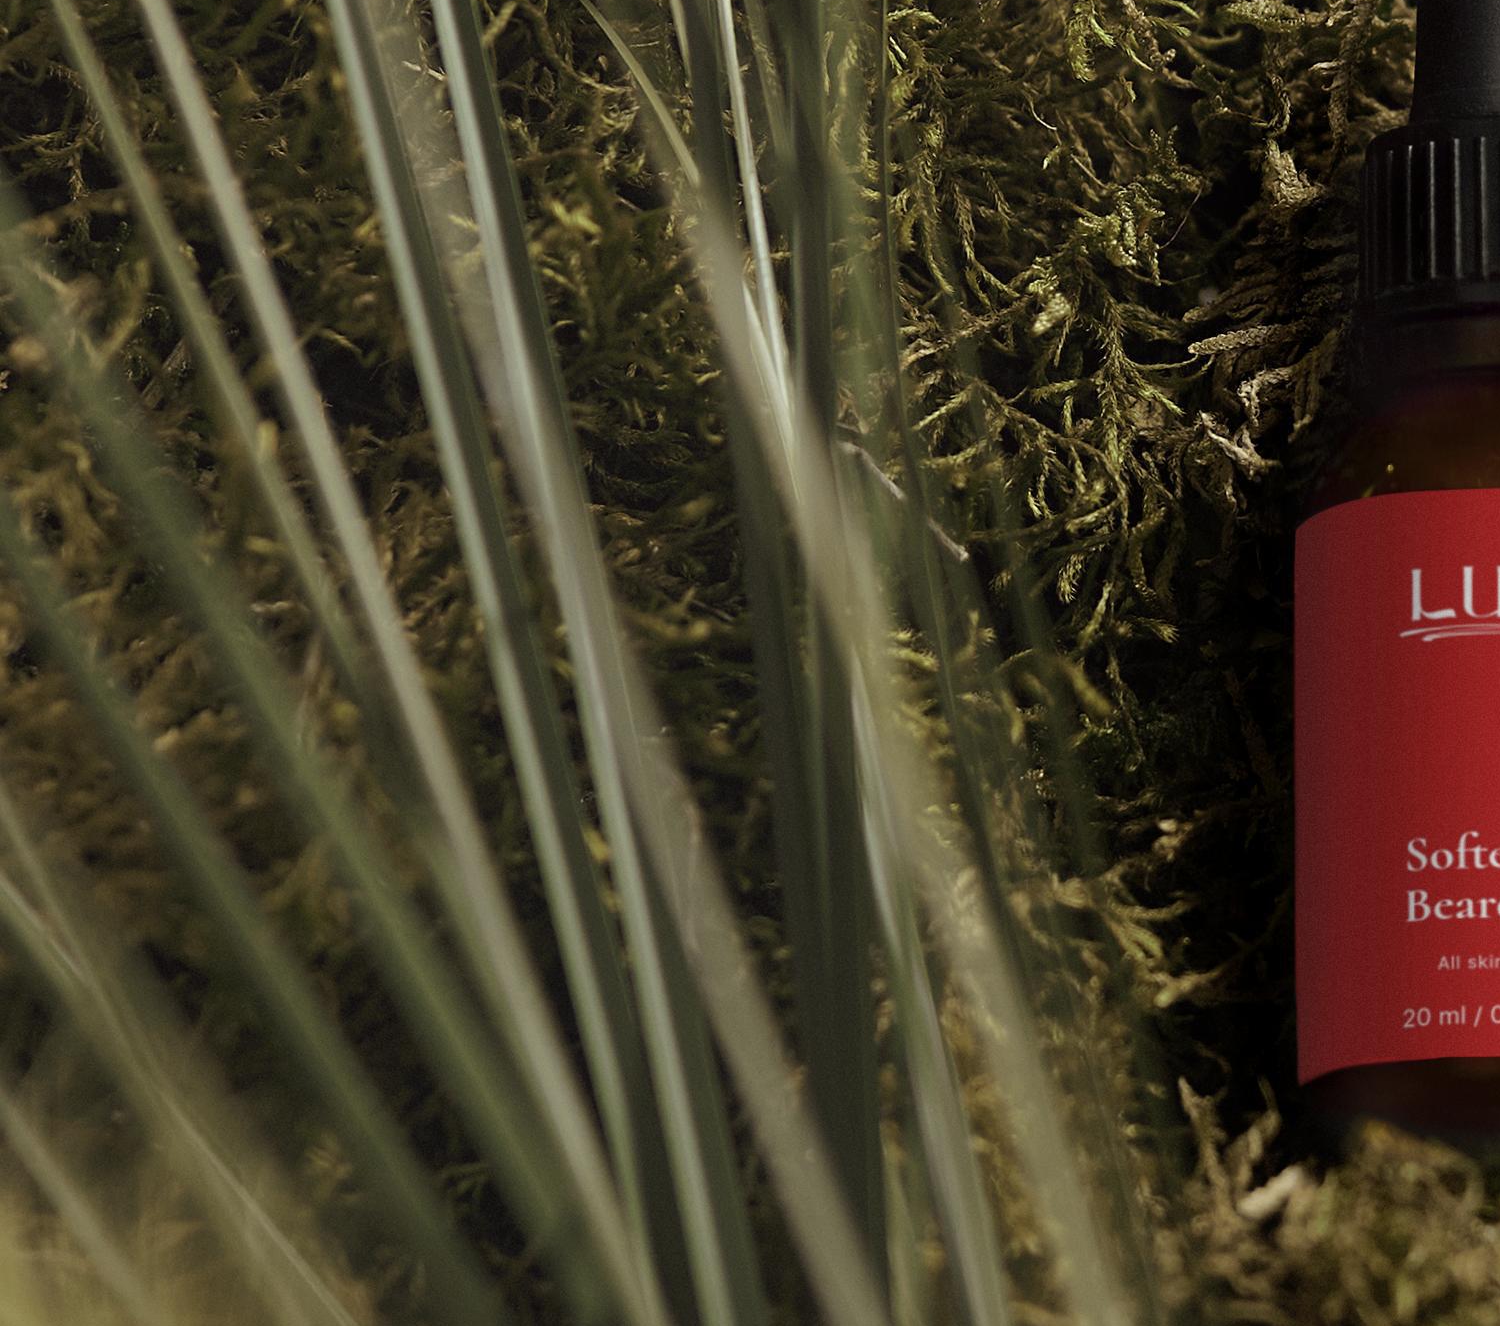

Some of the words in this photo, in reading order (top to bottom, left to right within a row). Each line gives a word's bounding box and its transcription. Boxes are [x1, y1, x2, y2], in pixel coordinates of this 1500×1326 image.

[1437, 956, 1461, 970] All
[1403, 1008, 1431, 1029] 20
[1439, 1006, 1466, 1025] ml
[1473, 1006, 1483, 1028] /
